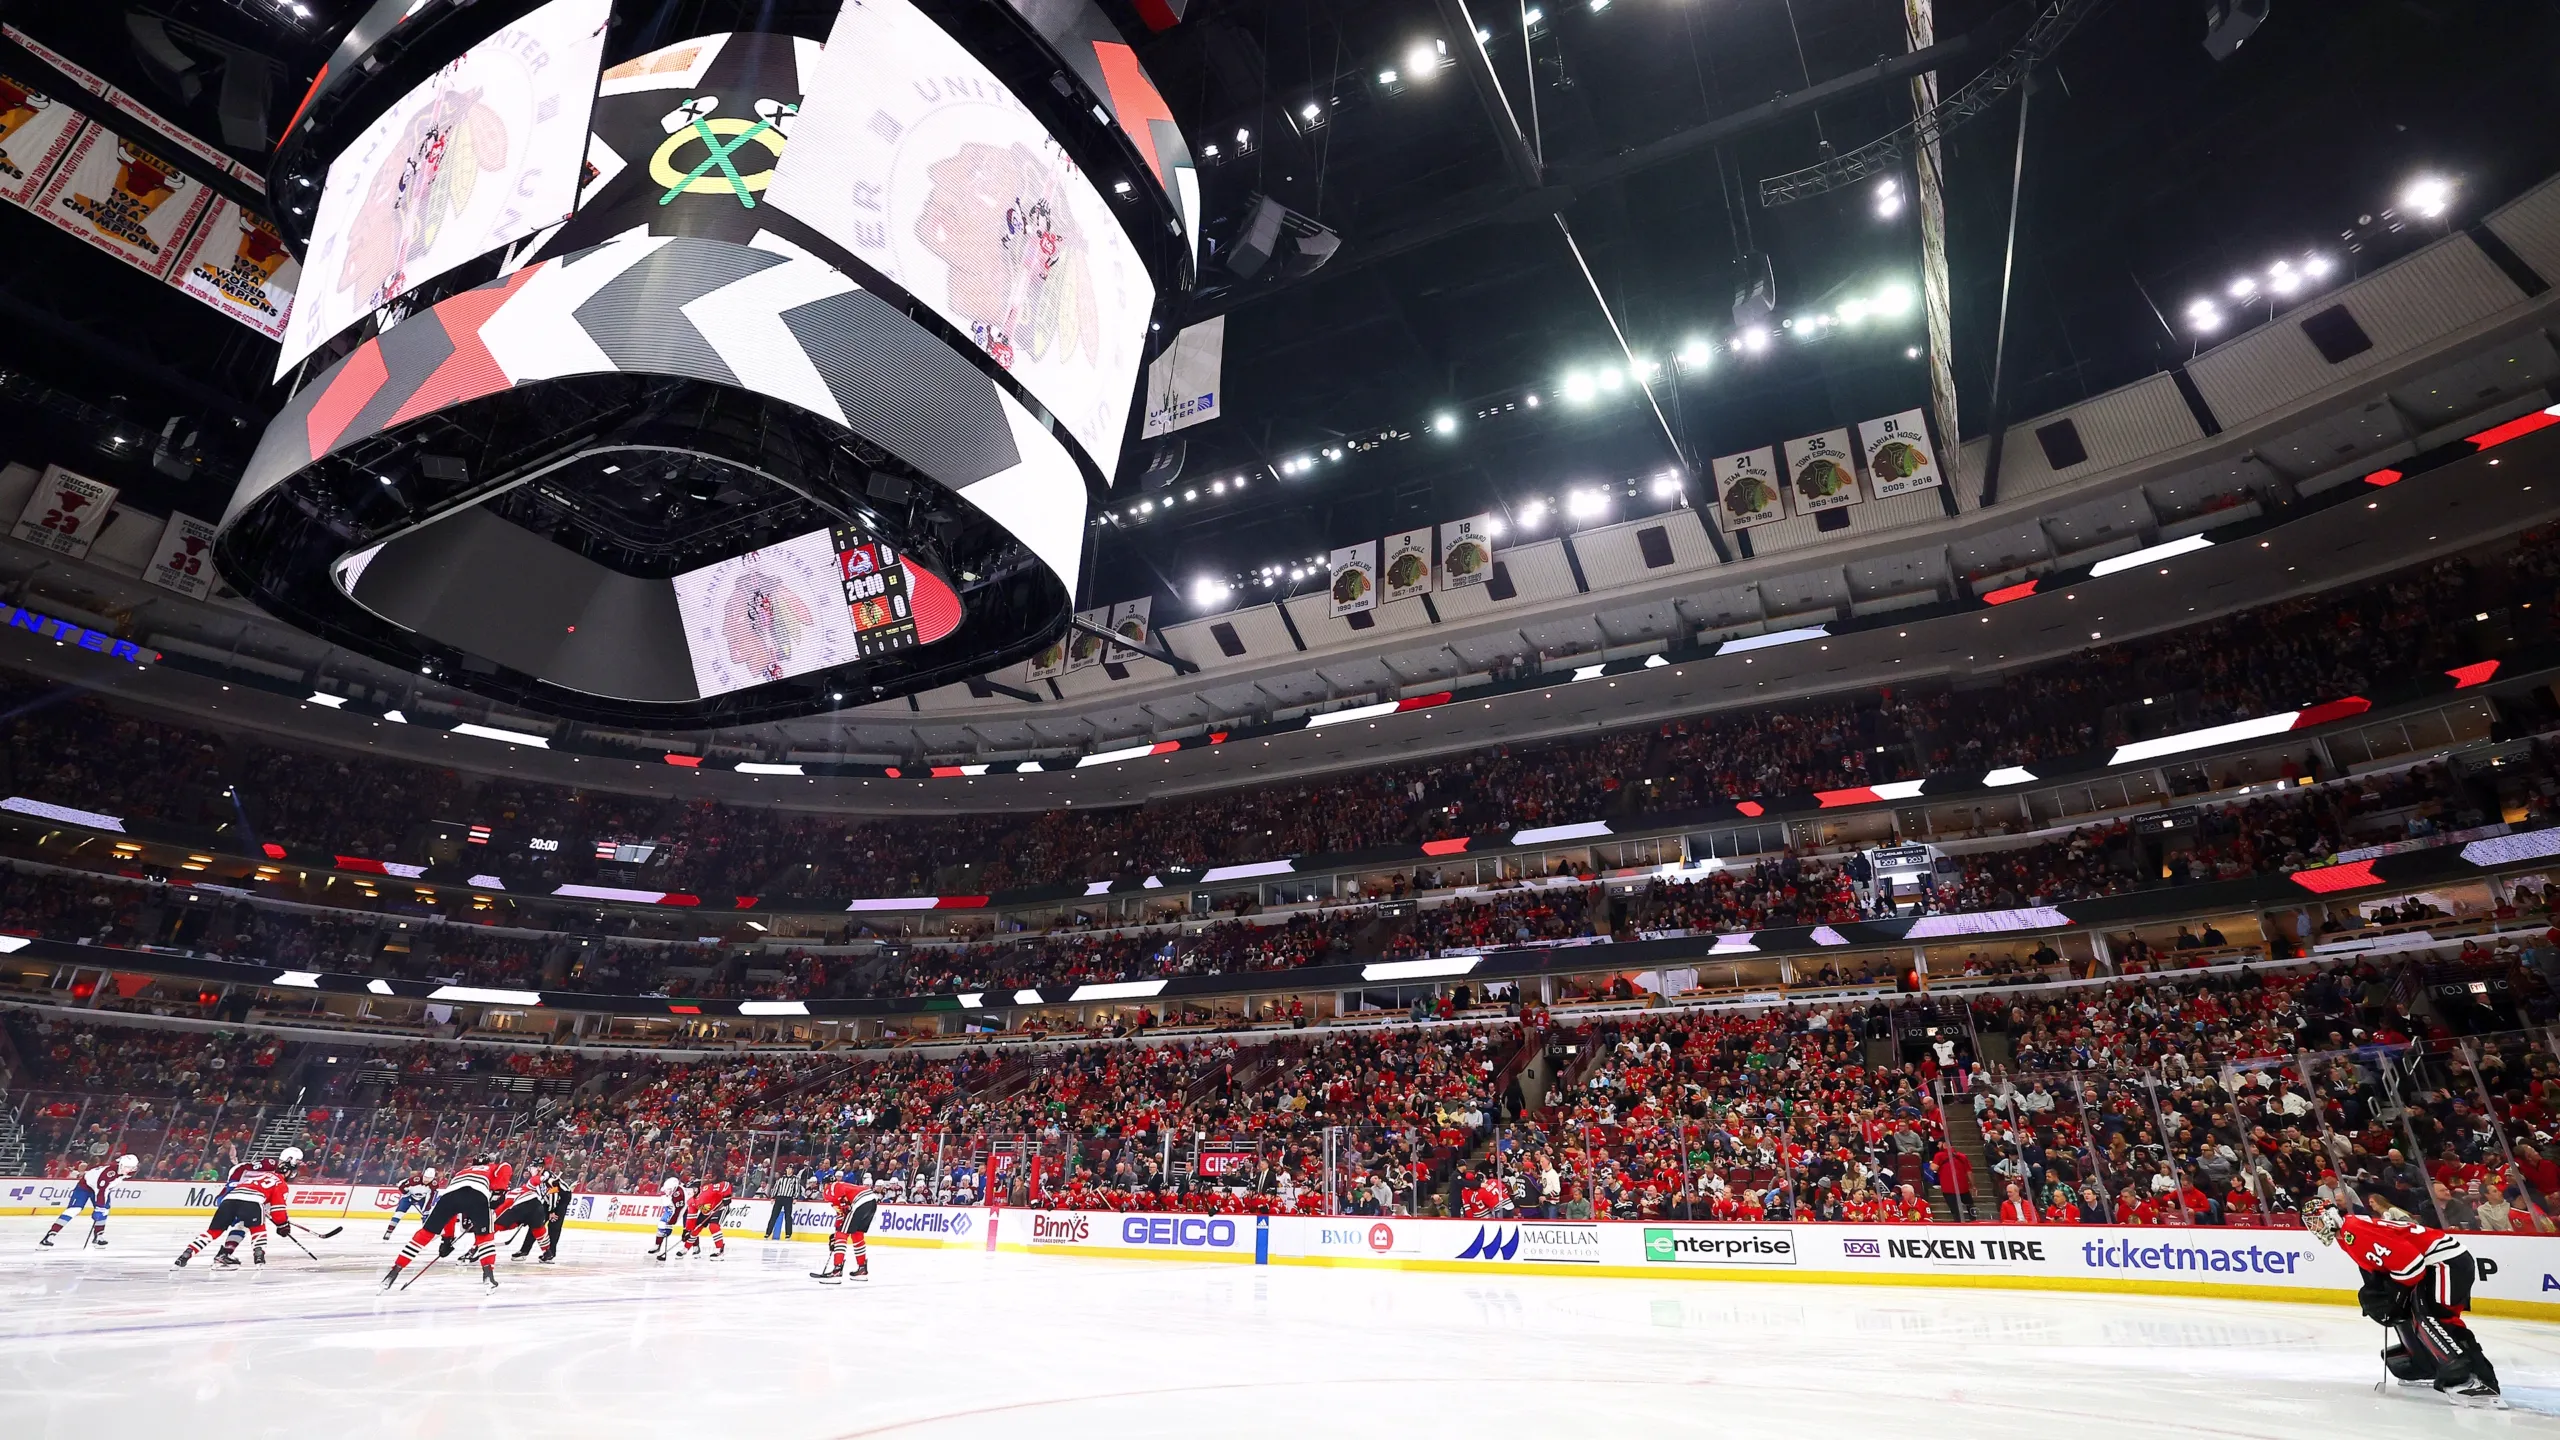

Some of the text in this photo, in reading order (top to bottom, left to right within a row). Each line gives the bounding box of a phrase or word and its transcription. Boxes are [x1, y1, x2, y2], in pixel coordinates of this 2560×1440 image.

[105, 197, 138, 220] NBA
[111, 187, 150, 214] 1992
[62, 197, 160, 255] CHAMPIONS
[89, 199, 147, 235] WORLD
[231, 265, 259, 285] NBA
[235, 255, 267, 278] 1993
[193, 268, 278, 317] CHAMPIONS
[216, 267, 266, 299] WORLD
[1884, 419, 1899, 433] 81
[1808, 438, 1826, 450] 35
[1868, 431, 1922, 453] MARIAN HOSSA
[1736, 455, 1751, 469] 21
[1795, 449, 1846, 468] TONY ESPOSITO
[60, 474, 103, 494] CHICAGO
[1723, 467, 1768, 485] STAN MIKITA
[63, 482, 94, 498] BULLS
[41, 508, 80, 534] 23
[183, 520, 214, 535] CHICAG
[1459, 523, 1471, 534] 18
[1404, 535, 1410, 546] 9
[1446, 536, 1464, 551] DENIS
[881, 544, 893, 565] 0
[1350, 549, 1357, 560] 7
[1391, 545, 1425, 560] BOBBY HULL
[169, 552, 201, 575] 33
[1332, 560, 1372, 577] CHRIS CHELIOS
[846, 573, 885, 601] 20:00
[894, 595, 906, 617] 0
[1129, 604, 1135, 614] 3
[0, 603, 140, 663] NTER
[529, 837, 559, 851] 20:00
[2441, 985, 2463, 996] 103
[1908, 1029, 1923, 1037] 102
[1943, 1026, 1959, 1035] 103
[1552, 1047, 1563, 1055] 101
[292, 1190, 346, 1205] ESPN
[619, 1204, 650, 1217] BELLE
[792, 1208, 837, 1227] ticketm
[880, 1210, 949, 1232] BlockFills
[1122, 1217, 1235, 1247] GEICO
[1321, 1229, 1362, 1246] BMO
[1523, 1230, 1598, 1245] MAGELLAN
[1523, 1247, 1600, 1256] CORPORATION
[1651, 1236, 1791, 1257] enterprise
[1844, 1242, 1880, 1254] NEXEN
[1888, 1239, 2046, 1261] NEXEN TIRE
[2082, 1238, 2300, 1274] ticketmaster
[2365, 1243, 2392, 1267] 34
[2427, 1315, 2464, 1356] VAUGHN
